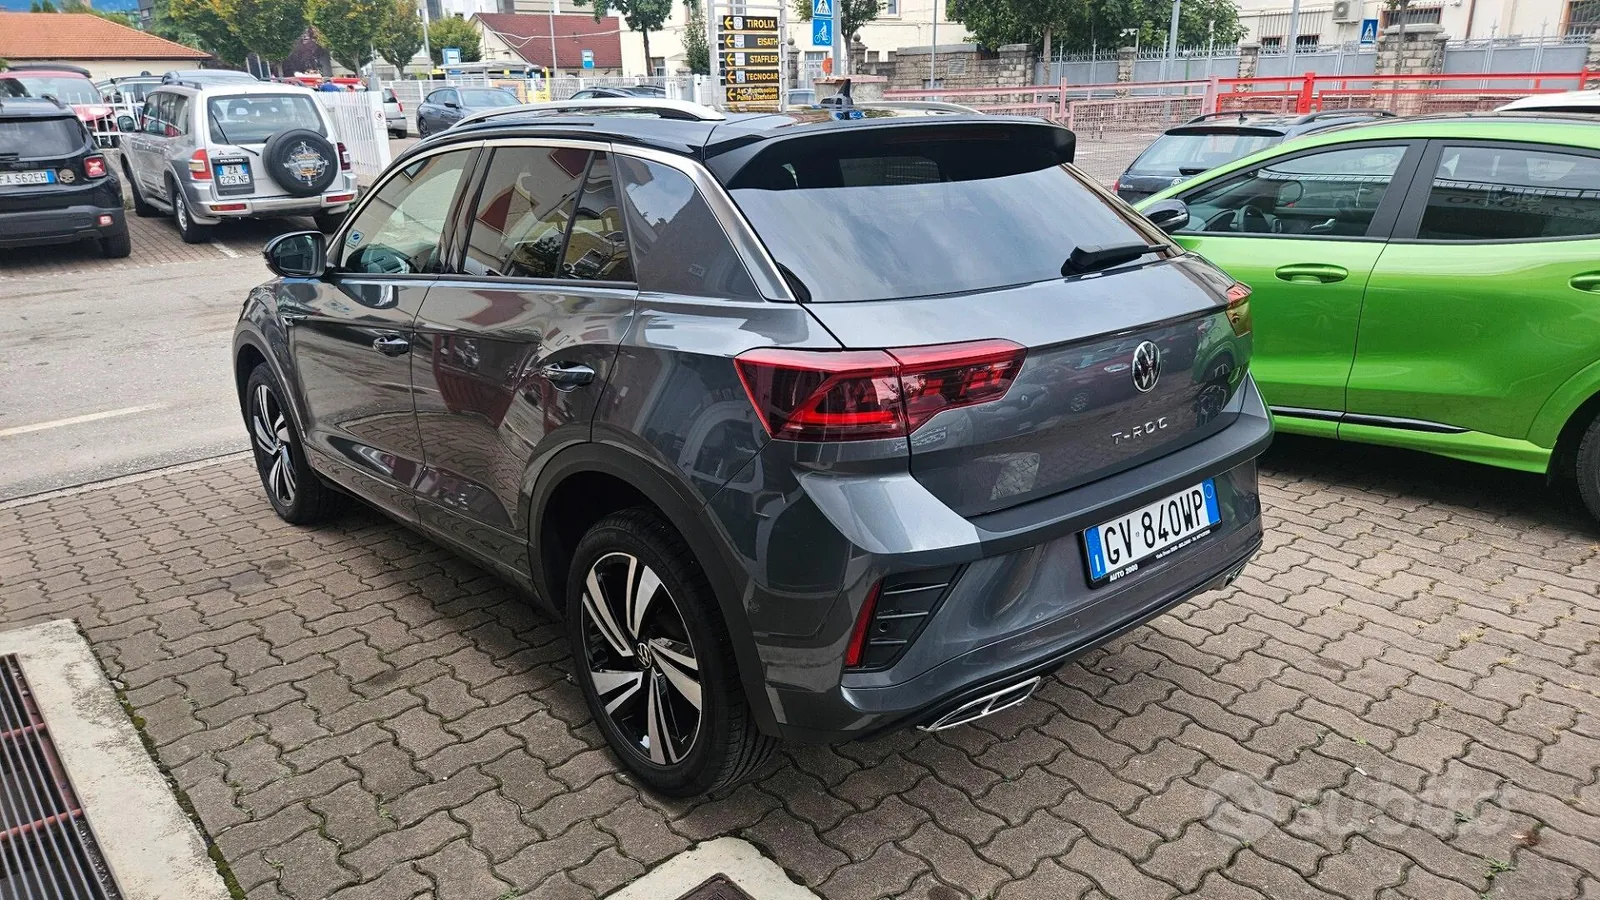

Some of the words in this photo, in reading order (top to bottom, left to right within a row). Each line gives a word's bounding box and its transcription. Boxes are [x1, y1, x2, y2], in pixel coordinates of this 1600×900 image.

[746, 19, 775, 29] TIROLIX
[757, 37, 778, 46] EISATH
[750, 55, 779, 64] STAFFLER
[746, 73, 778, 81] TECNOCAR
[1111, 417, 1168, 445] T-ROC
[1104, 518, 1133, 565] GV
[1141, 489, 1203, 549] 840WP
[1109, 570, 1125, 582] AUTO
